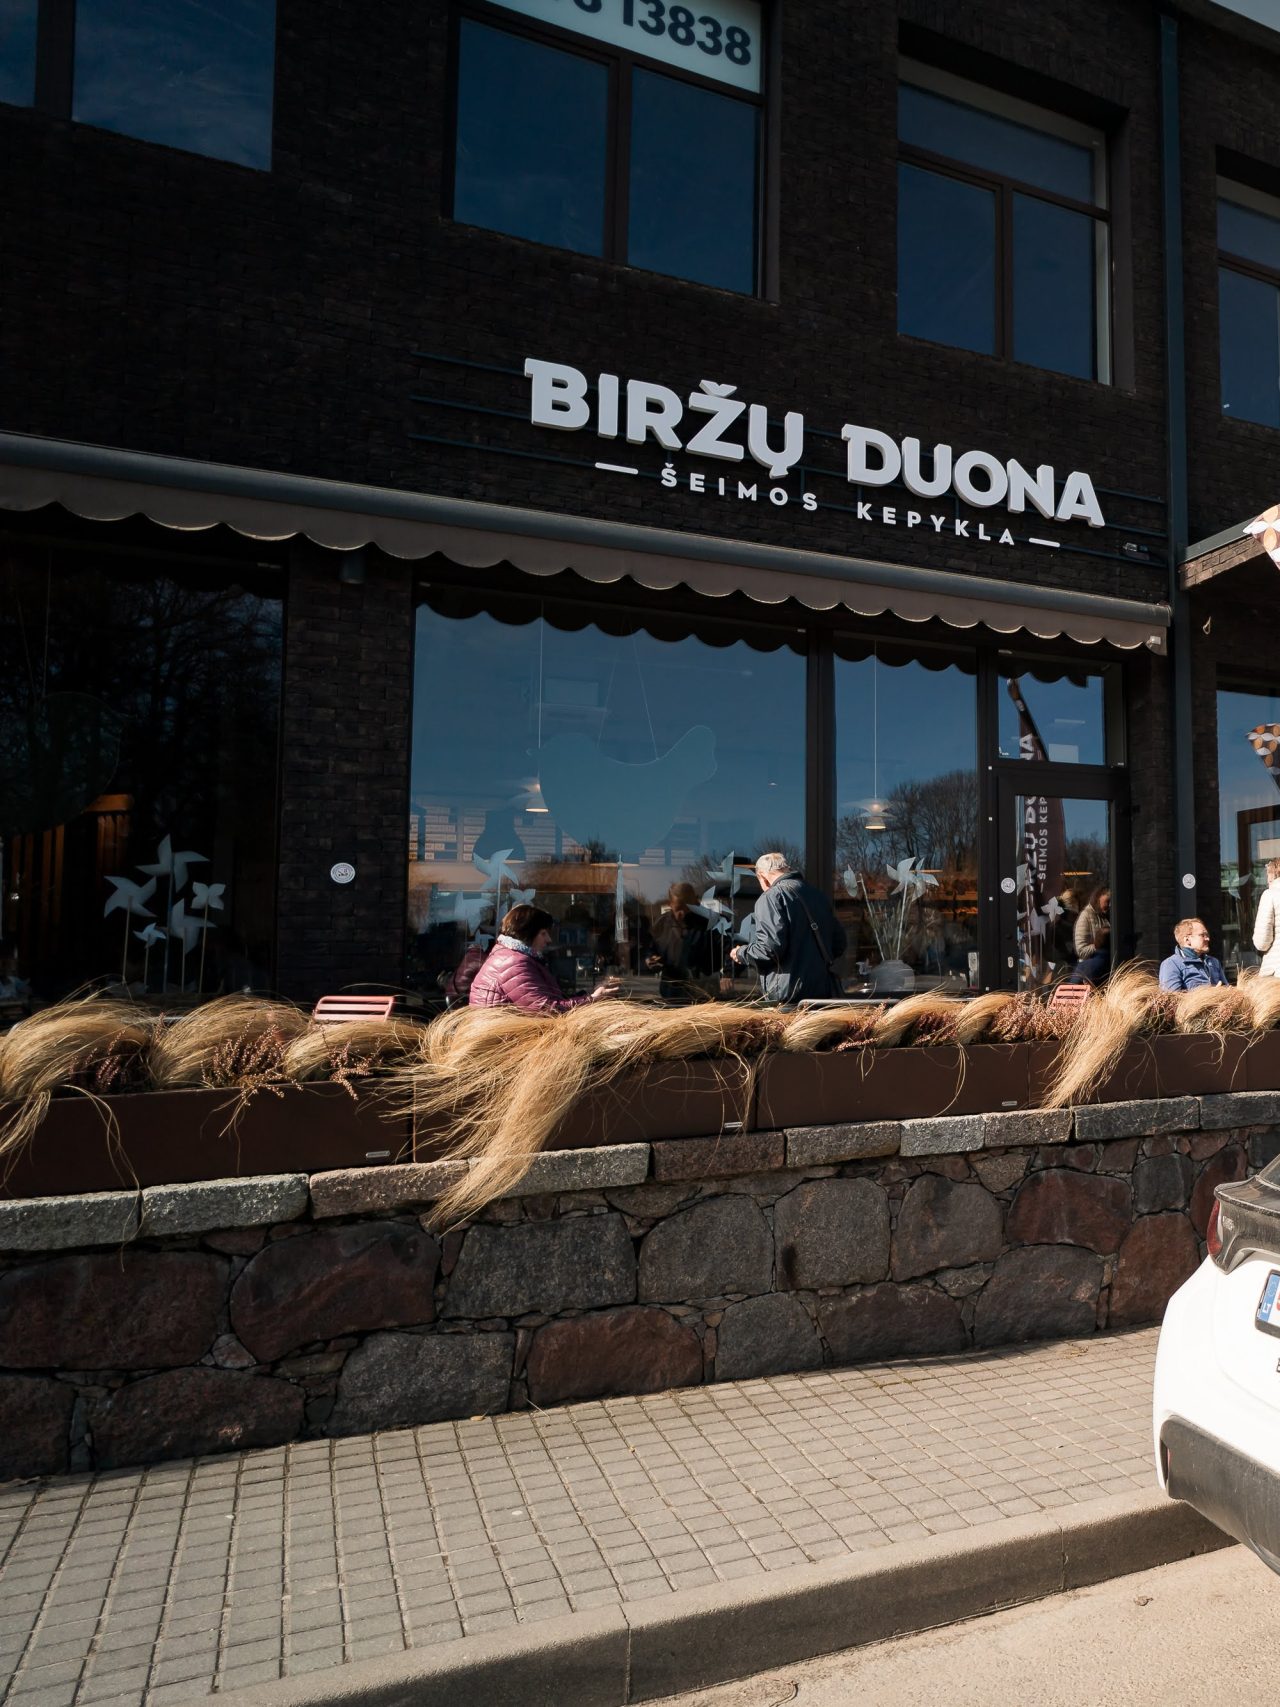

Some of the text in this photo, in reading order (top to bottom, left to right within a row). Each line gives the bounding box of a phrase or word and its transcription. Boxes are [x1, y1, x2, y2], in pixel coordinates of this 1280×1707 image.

[523, 357, 1106, 528] BIRŽŲ DUONA
[660, 461, 1015, 546] ŠEIMOS KEPYKLA
